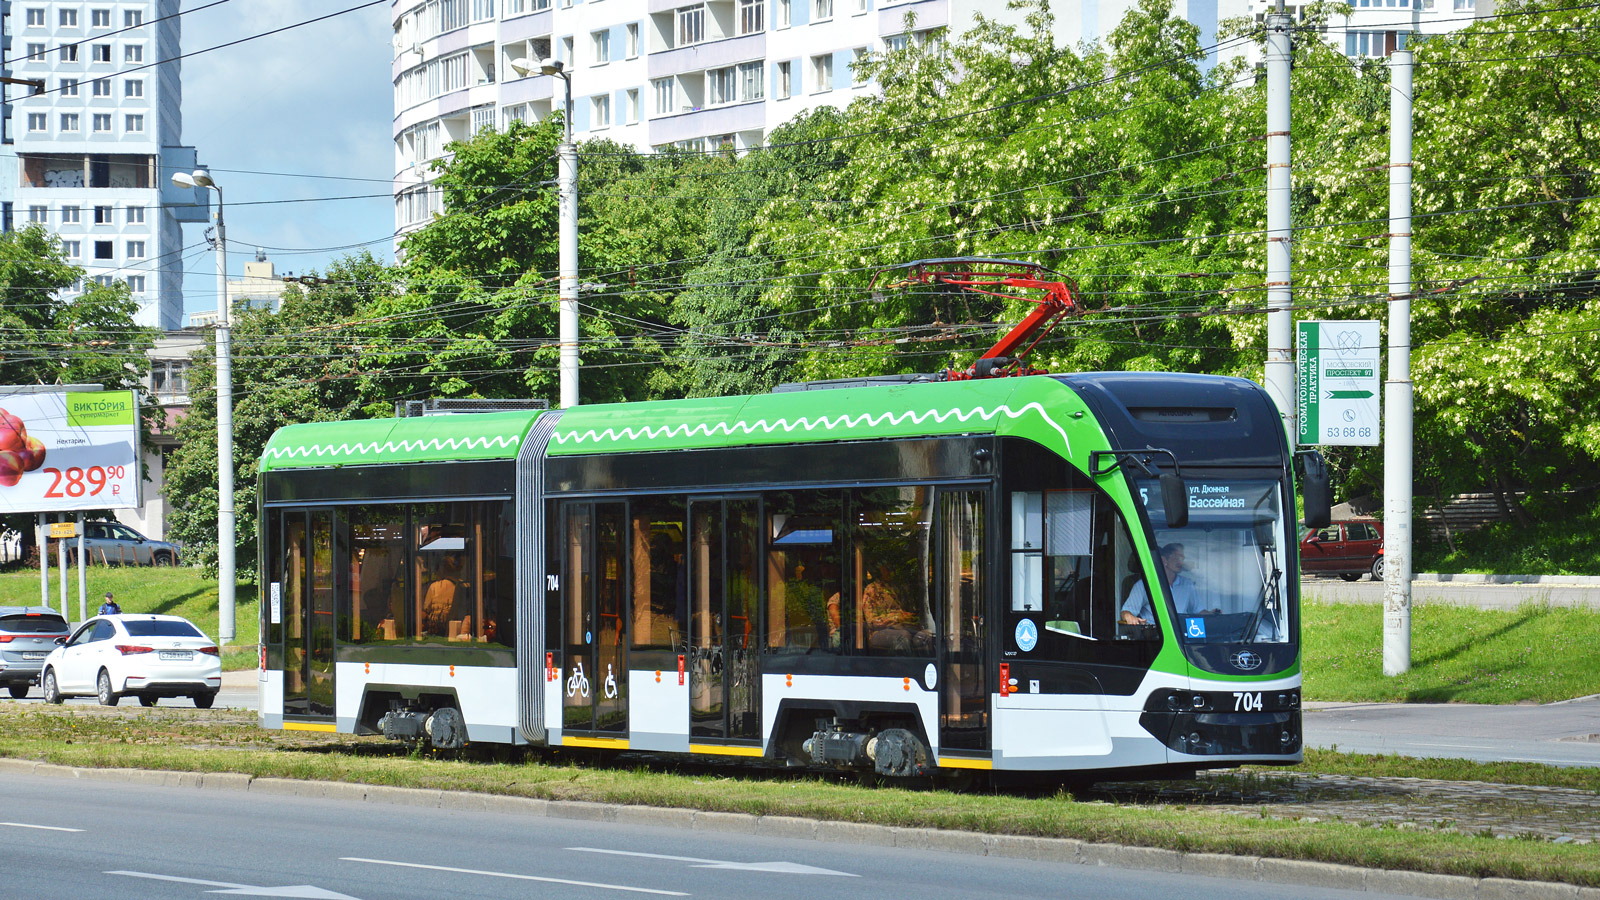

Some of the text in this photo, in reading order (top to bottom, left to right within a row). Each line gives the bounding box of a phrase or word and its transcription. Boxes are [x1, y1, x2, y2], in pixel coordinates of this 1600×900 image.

[1300, 331, 1308, 435] СТОМАТОЛОГИЧЕСКАЯ
[1327, 428, 1371, 437] 53 68 68
[42, 465, 125, 498] 289 90
[1189, 485, 1229, 494] ул. Дюнная
[1140, 488, 1149, 506] 5
[1189, 495, 1245, 508] Бассейная
[547, 575, 559, 591] 704
[1233, 692, 1263, 712] 704
